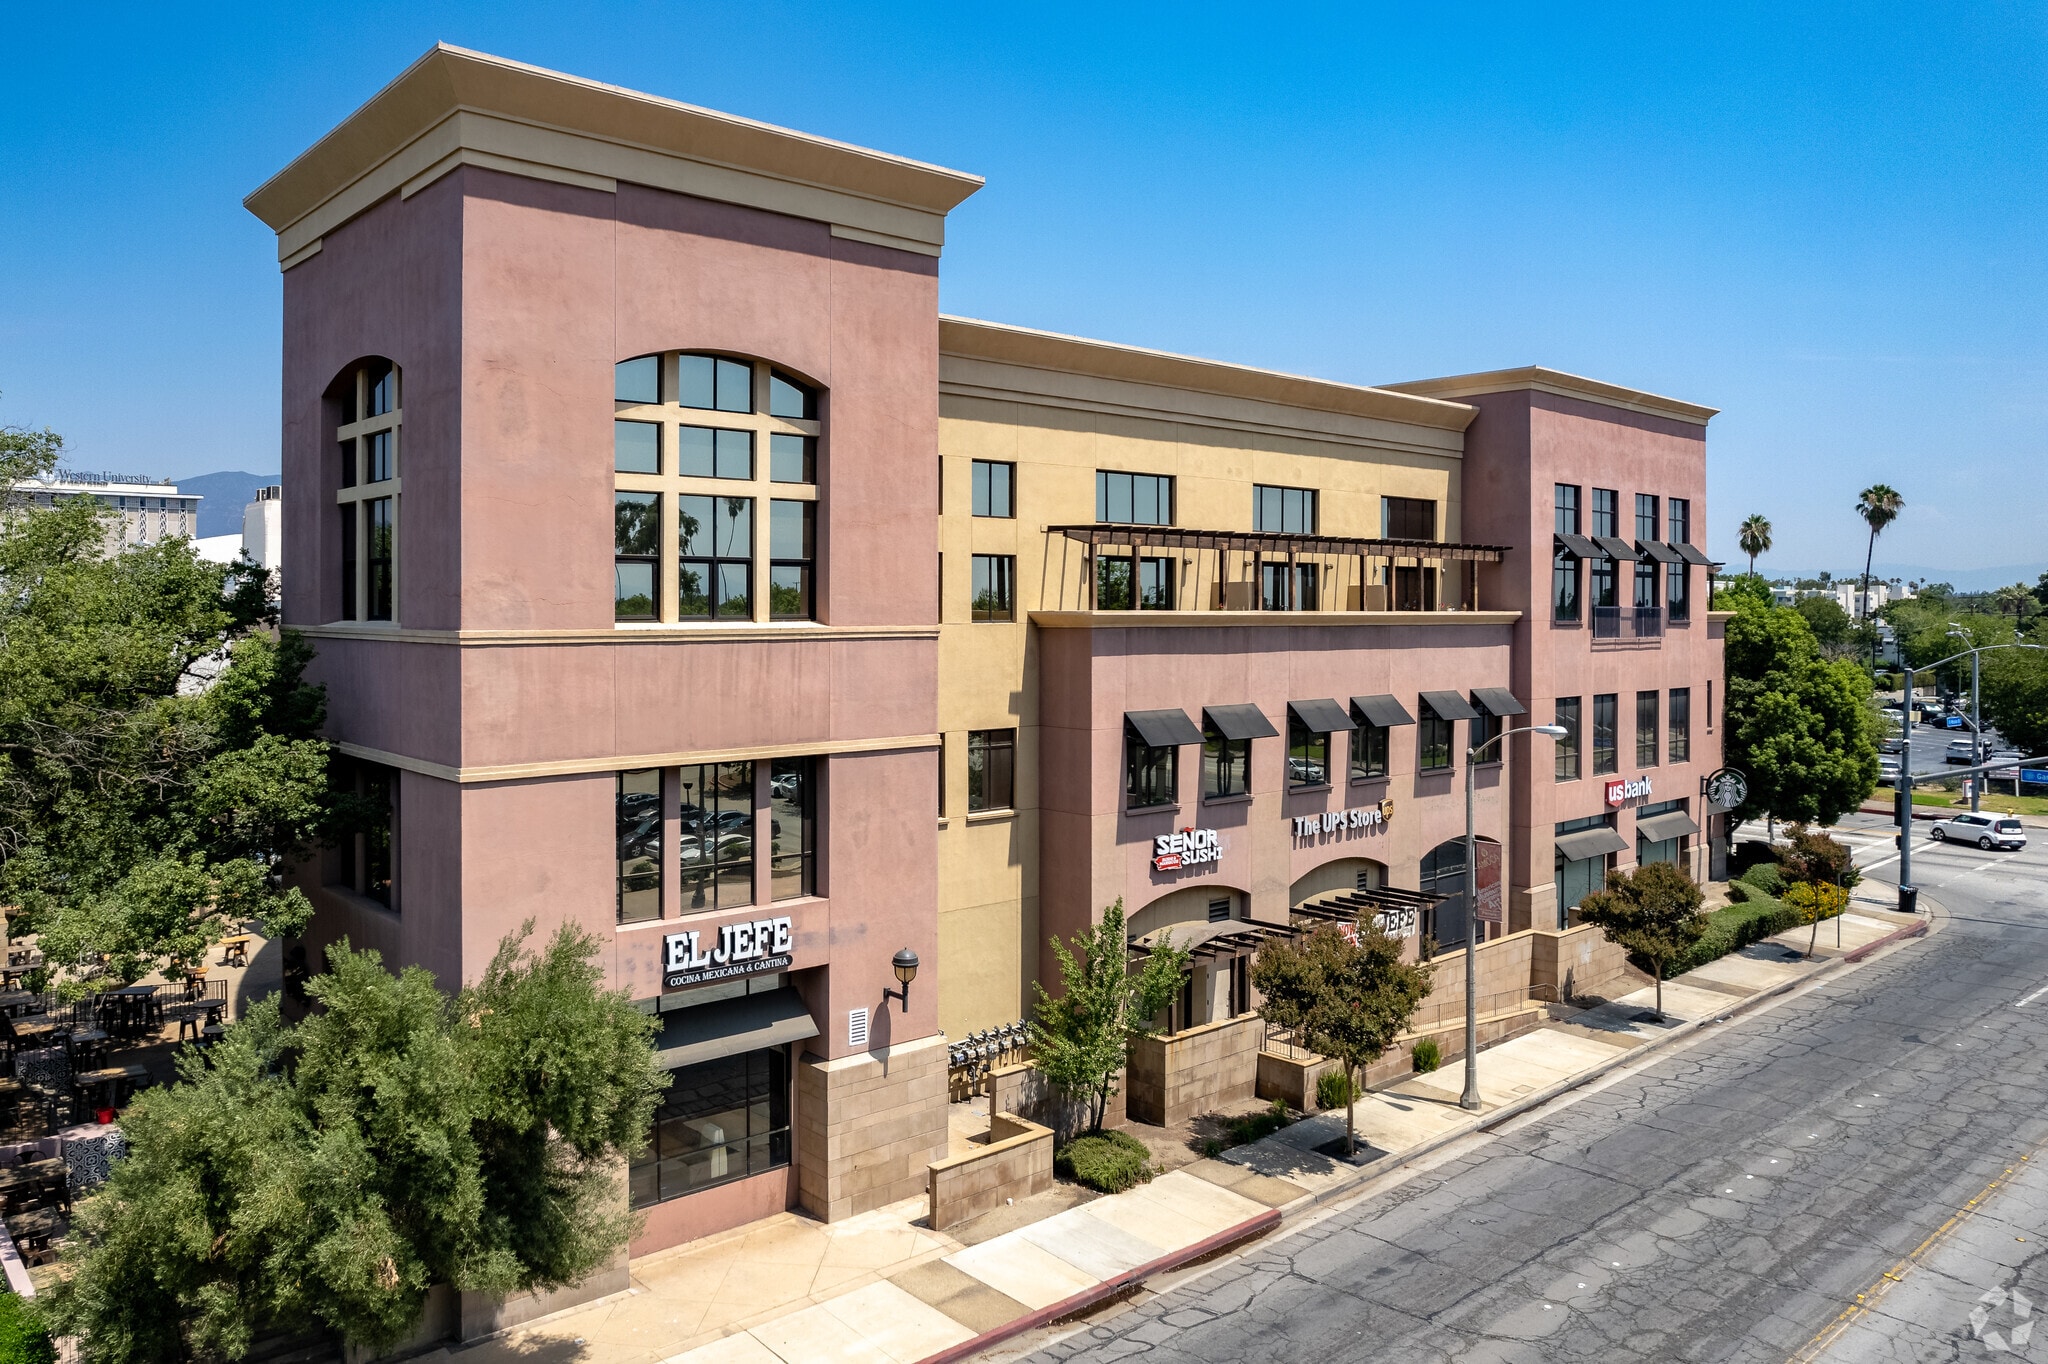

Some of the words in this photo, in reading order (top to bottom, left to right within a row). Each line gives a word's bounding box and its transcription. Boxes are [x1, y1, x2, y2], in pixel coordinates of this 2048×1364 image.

[58, 468, 100, 481] Western
[103, 470, 151, 483] University
[1295, 817, 1321, 837] The
[1322, 809, 1348, 833] UPS
[1350, 808, 1382, 829] Store
[1156, 827, 1218, 855] SEÑOR
[1181, 846, 1223, 865] SUSHI
[666, 930, 711, 973] EL
[713, 916, 793, 963] JEFE
[670, 974, 701, 987] COCINA
[702, 965, 745, 981] MEXICANA
[746, 963, 753, 973] &
[754, 956, 788, 971] CANTINA
